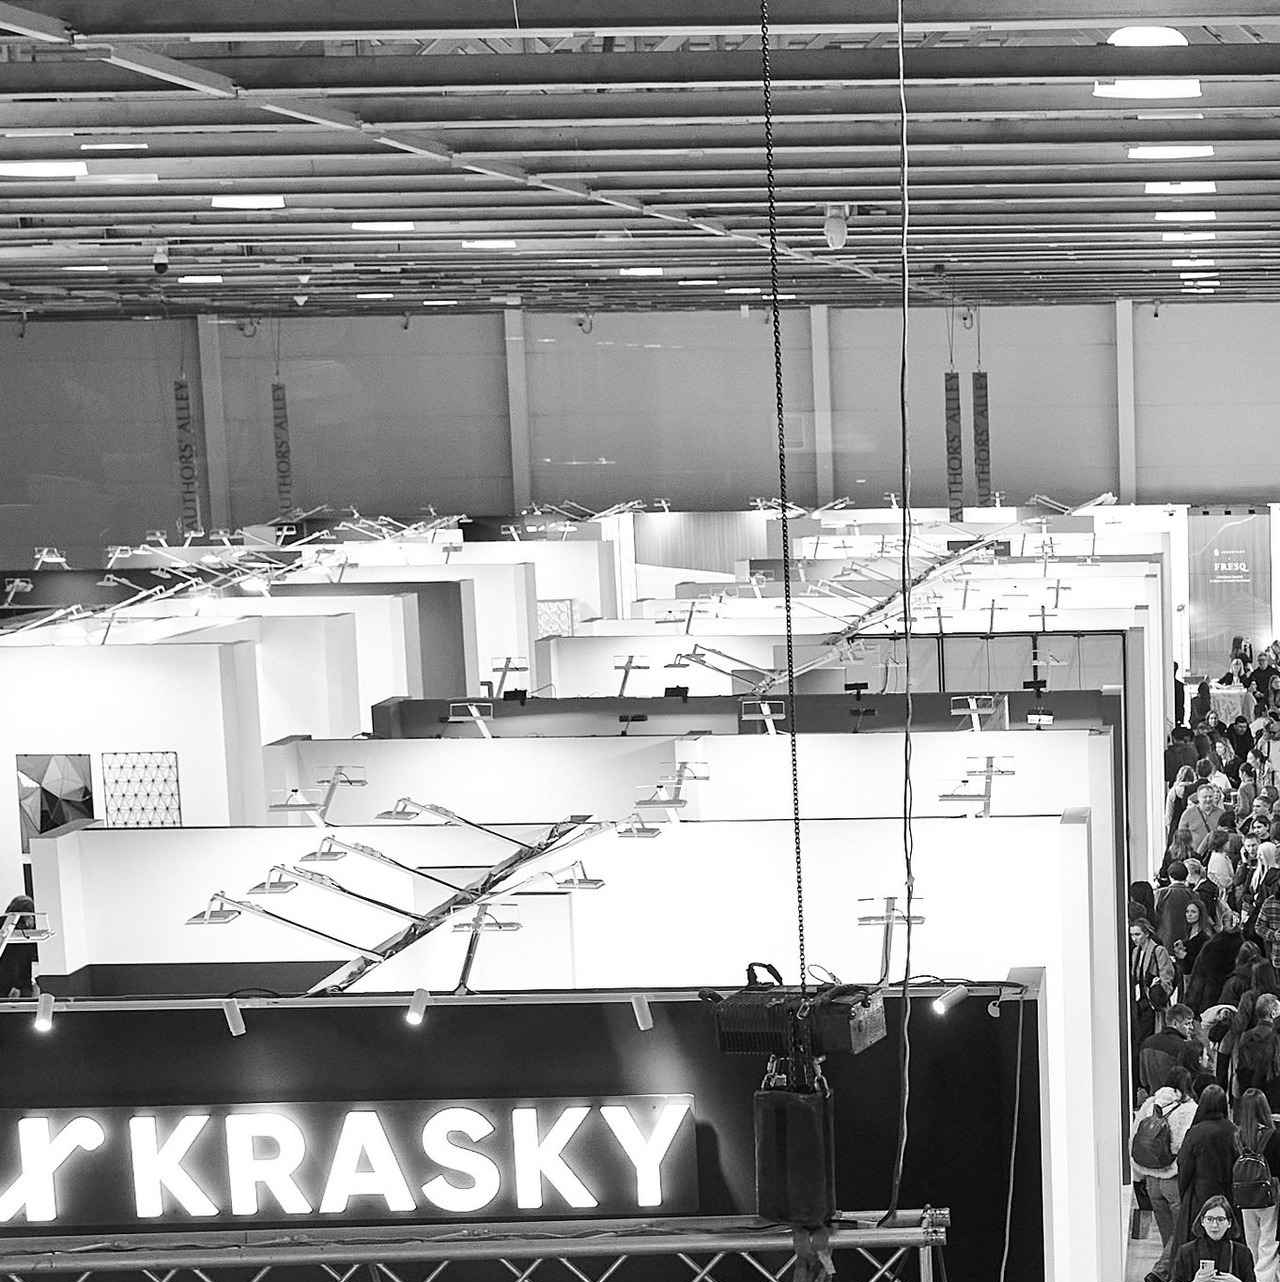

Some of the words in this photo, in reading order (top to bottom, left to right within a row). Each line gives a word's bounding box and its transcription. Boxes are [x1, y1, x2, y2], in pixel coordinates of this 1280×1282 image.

[174, 381, 193, 433] ALLEY
[272, 384, 289, 431] ALLEY
[945, 373, 961, 424] ALLEY
[975, 373, 988, 417] ALLEY
[128, 1103, 692, 1219] KRASKY
